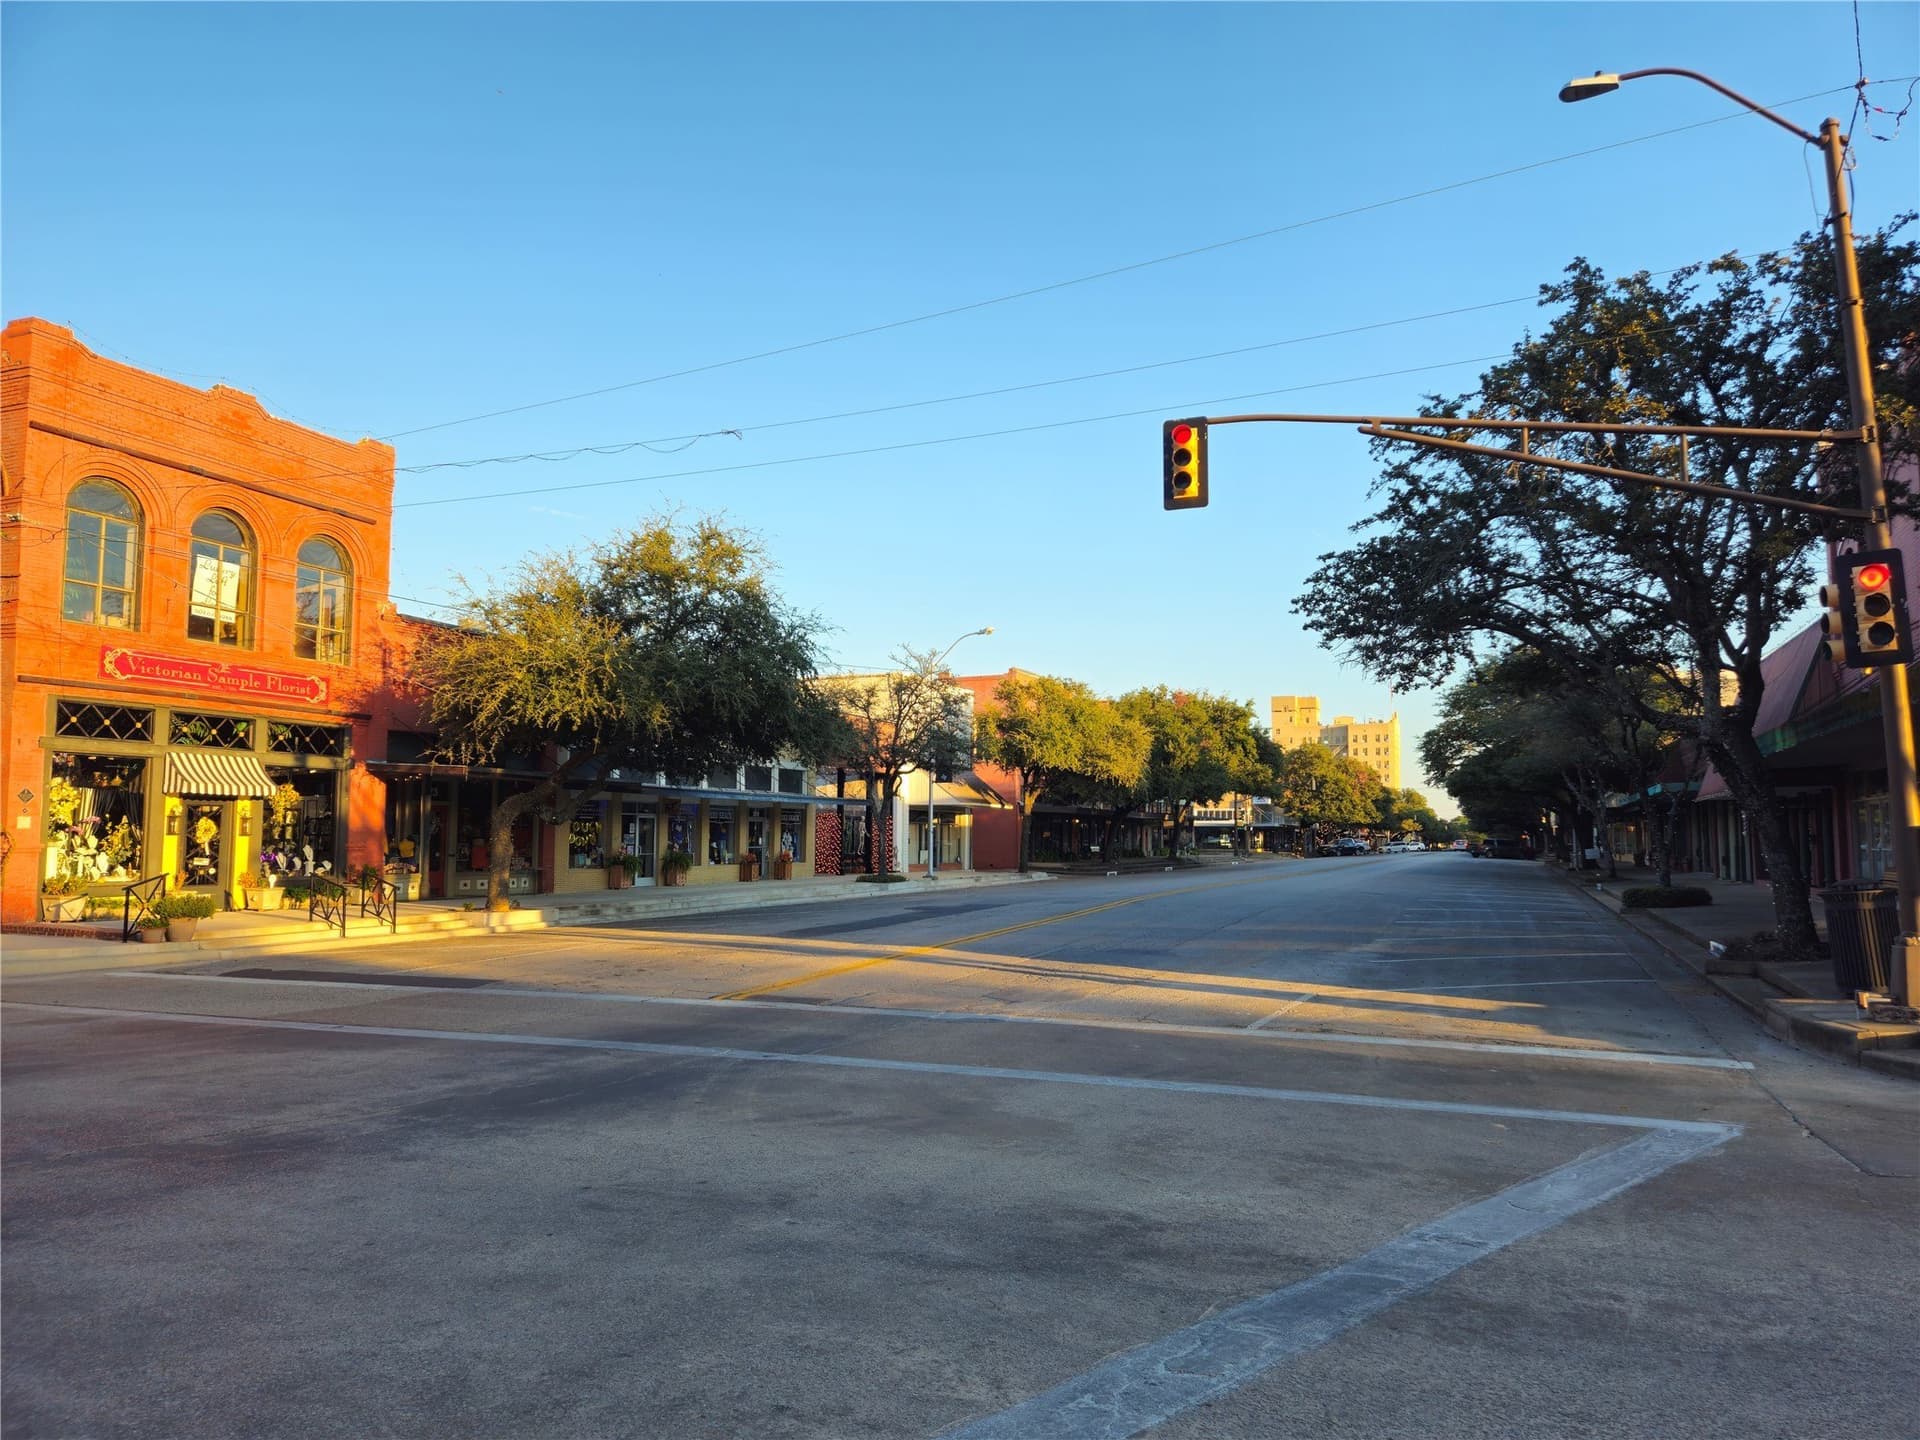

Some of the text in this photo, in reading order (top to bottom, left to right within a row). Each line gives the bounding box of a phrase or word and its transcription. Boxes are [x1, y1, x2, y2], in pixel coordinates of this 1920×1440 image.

[127, 656, 312, 695] Victorian Sample Florist
